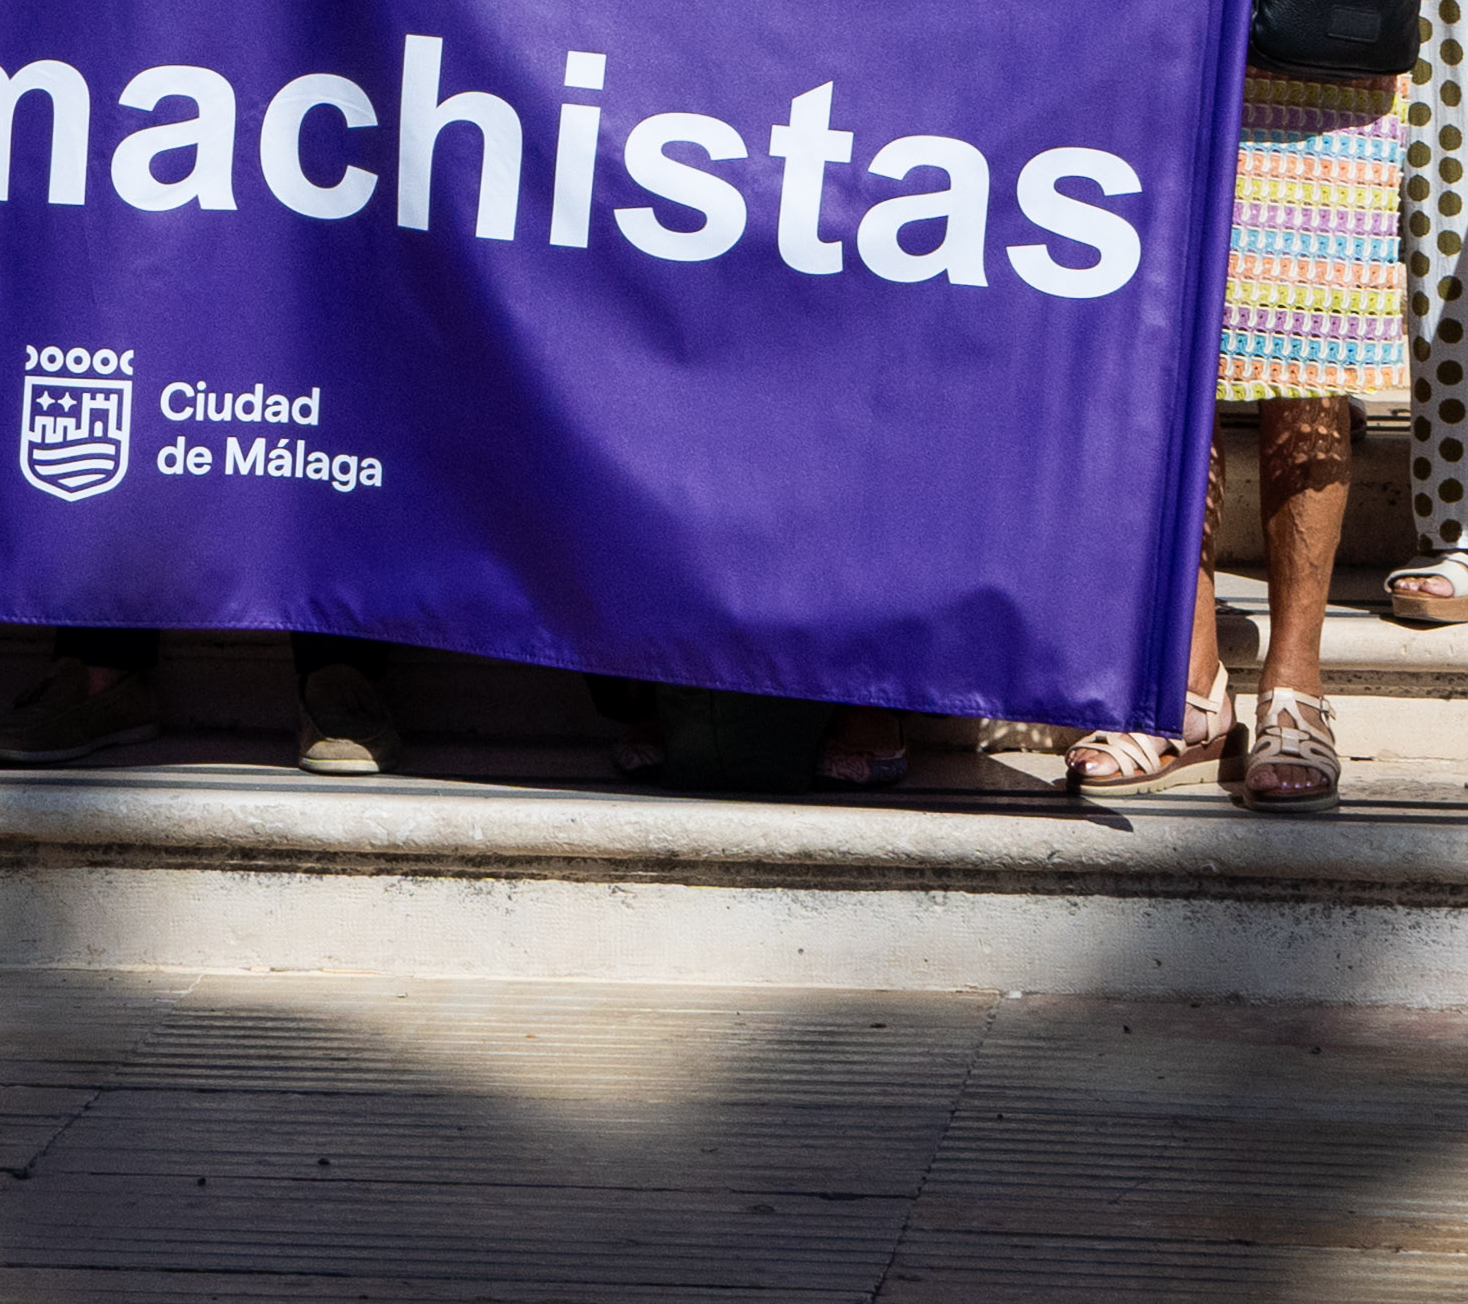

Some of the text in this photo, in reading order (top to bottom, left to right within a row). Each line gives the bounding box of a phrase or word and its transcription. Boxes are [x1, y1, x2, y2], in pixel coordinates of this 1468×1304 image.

[160, 379, 322, 426] Ciudad
[156, 434, 384, 494] de Málaga
